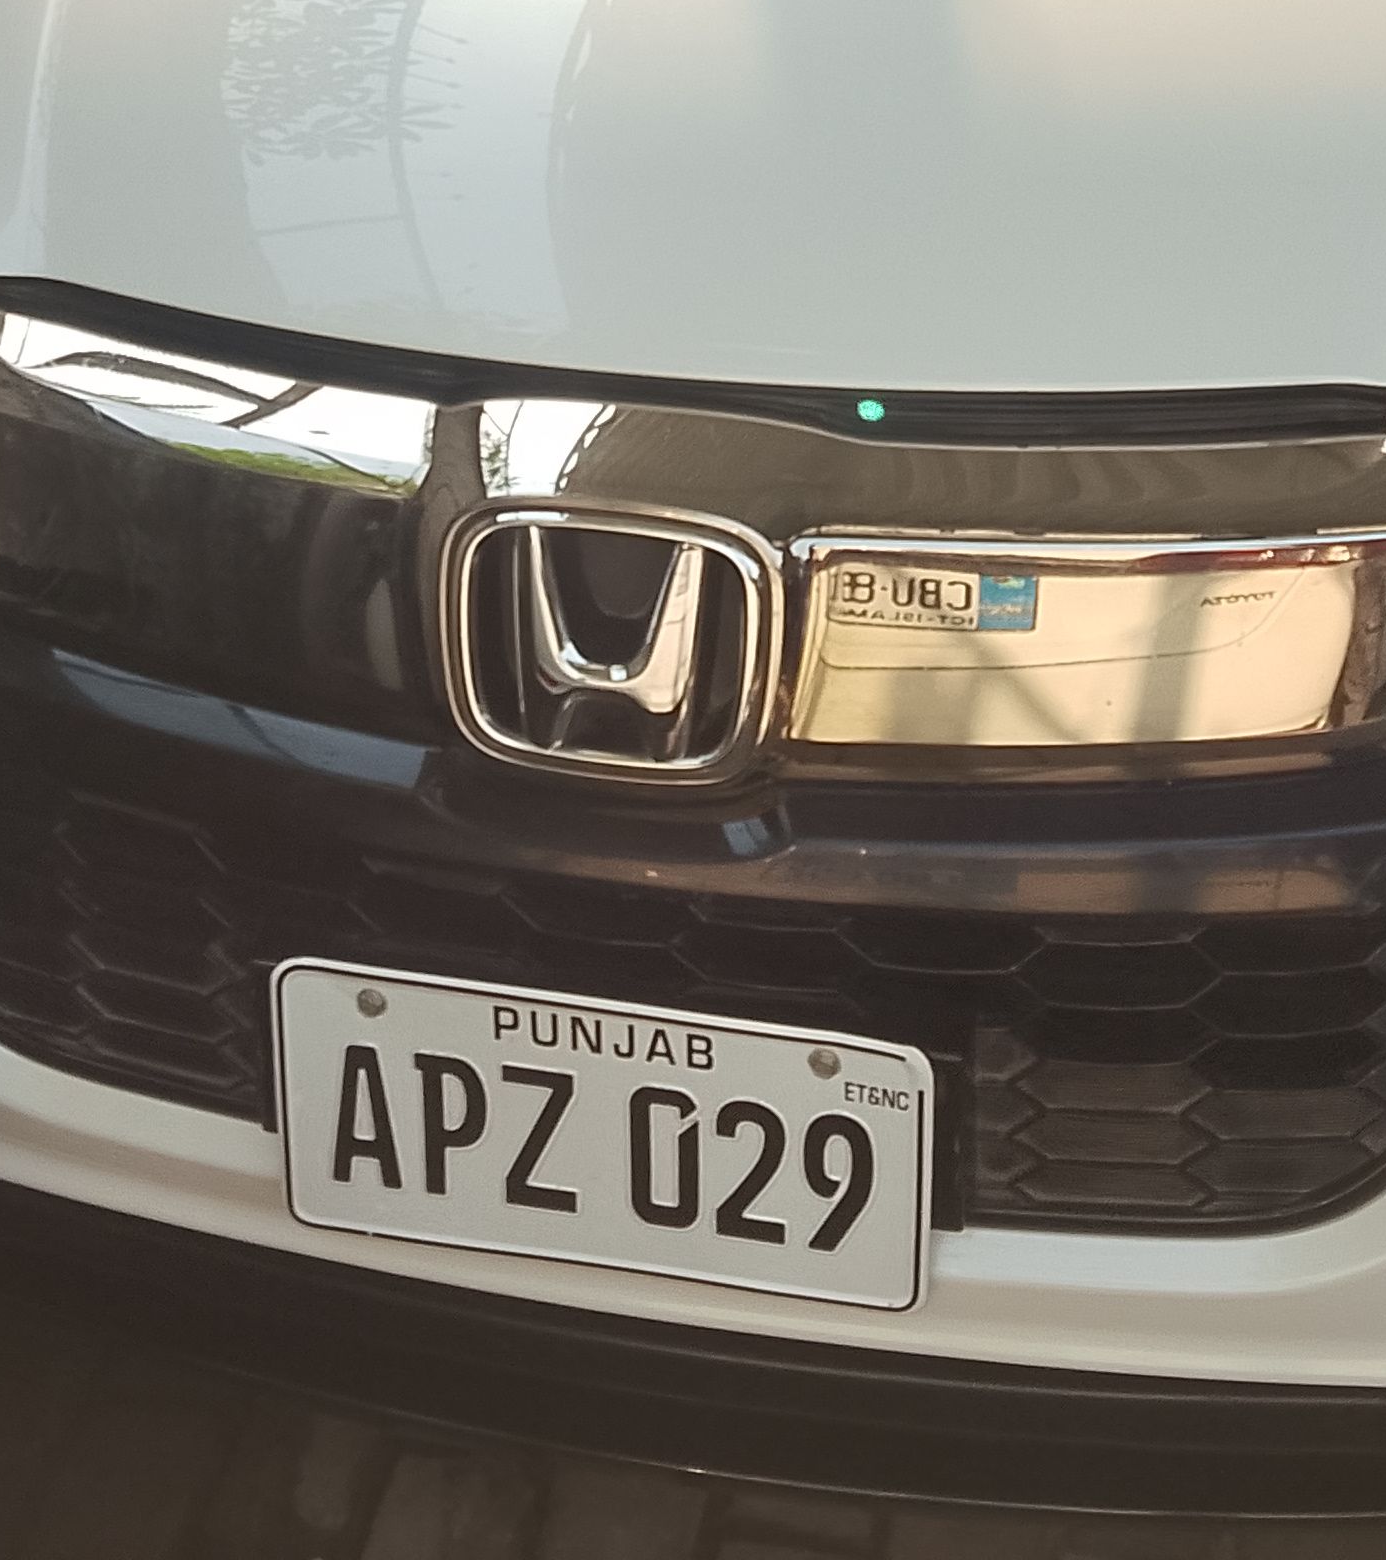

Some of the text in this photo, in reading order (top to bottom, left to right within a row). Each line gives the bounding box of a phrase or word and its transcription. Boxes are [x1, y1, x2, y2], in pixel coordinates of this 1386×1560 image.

[493, 1005, 716, 1072] PUNJAB
[843, 1080, 910, 1112] ET&NC
[332, 1043, 875, 1253] APZ 029
